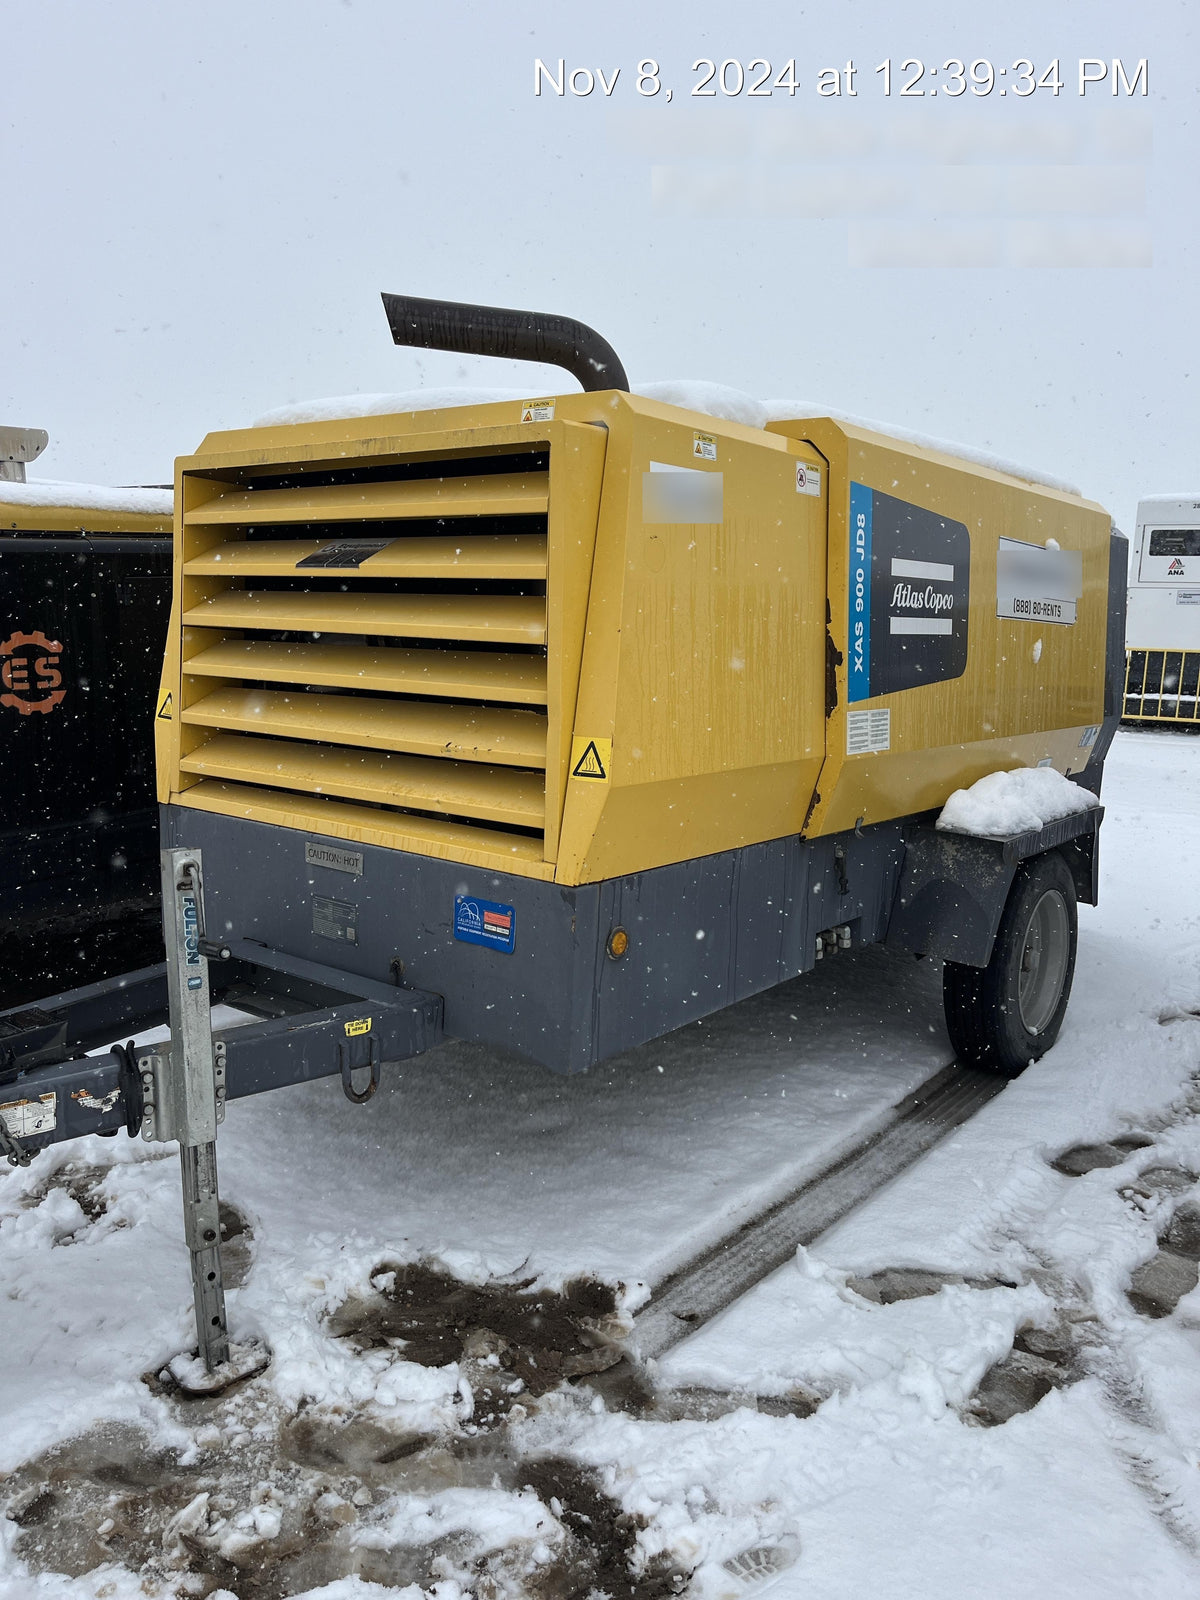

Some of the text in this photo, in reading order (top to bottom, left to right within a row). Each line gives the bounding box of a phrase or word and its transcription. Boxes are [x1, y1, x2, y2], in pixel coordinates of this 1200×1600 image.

[854, 513, 866, 673] XAS 900 JD8
[890, 583, 954, 614] Atlas Copco
[1013, 597, 1032, 615] (888)
[308, 848, 360, 868] CAUTION: HOT
